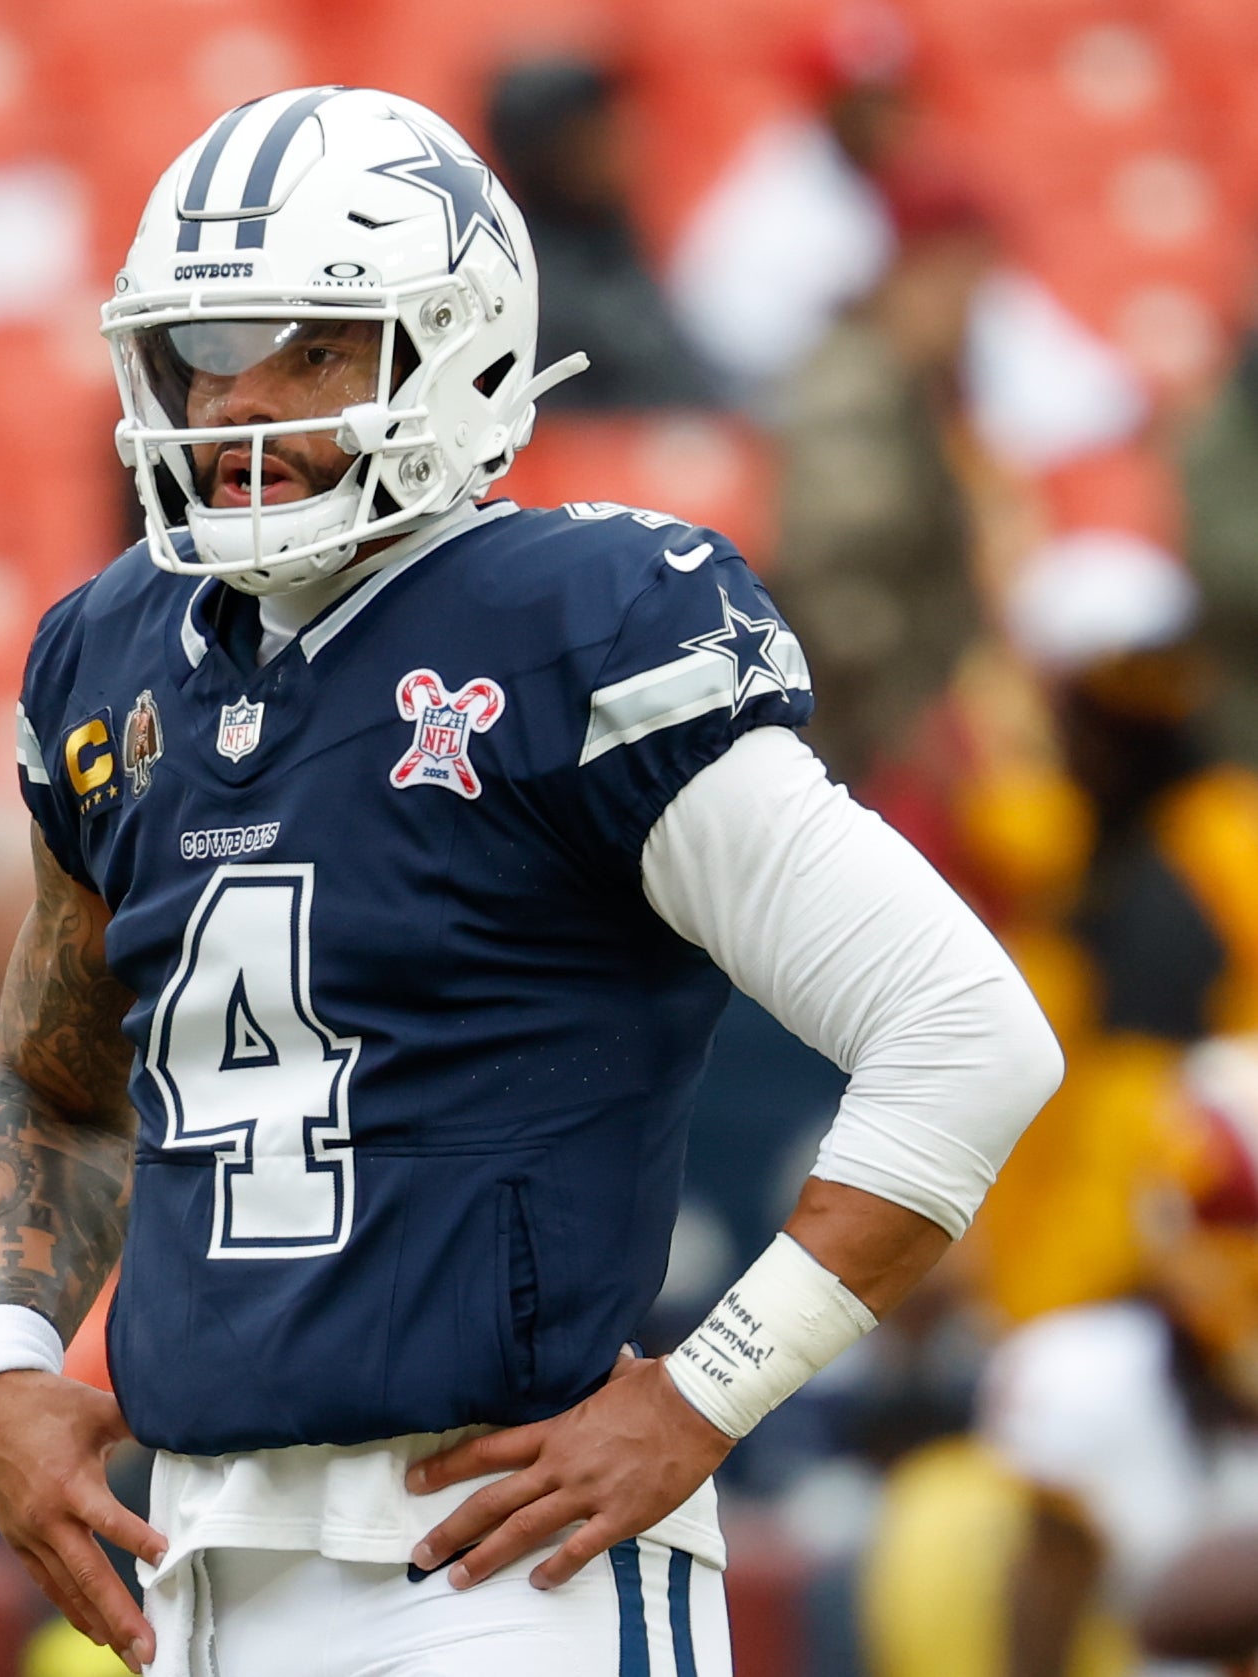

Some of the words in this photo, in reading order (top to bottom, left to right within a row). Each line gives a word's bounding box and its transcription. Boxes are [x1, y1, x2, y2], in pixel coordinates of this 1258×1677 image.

[174, 262, 254, 281] COWBOYS
[224, 724, 251, 751] NFL
[422, 726, 458, 755] NFL
[65, 718, 114, 796] C
[423, 767, 449, 780] 2025
[180, 821, 281, 860] COWBOYS
[145, 863, 362, 1260] 4
